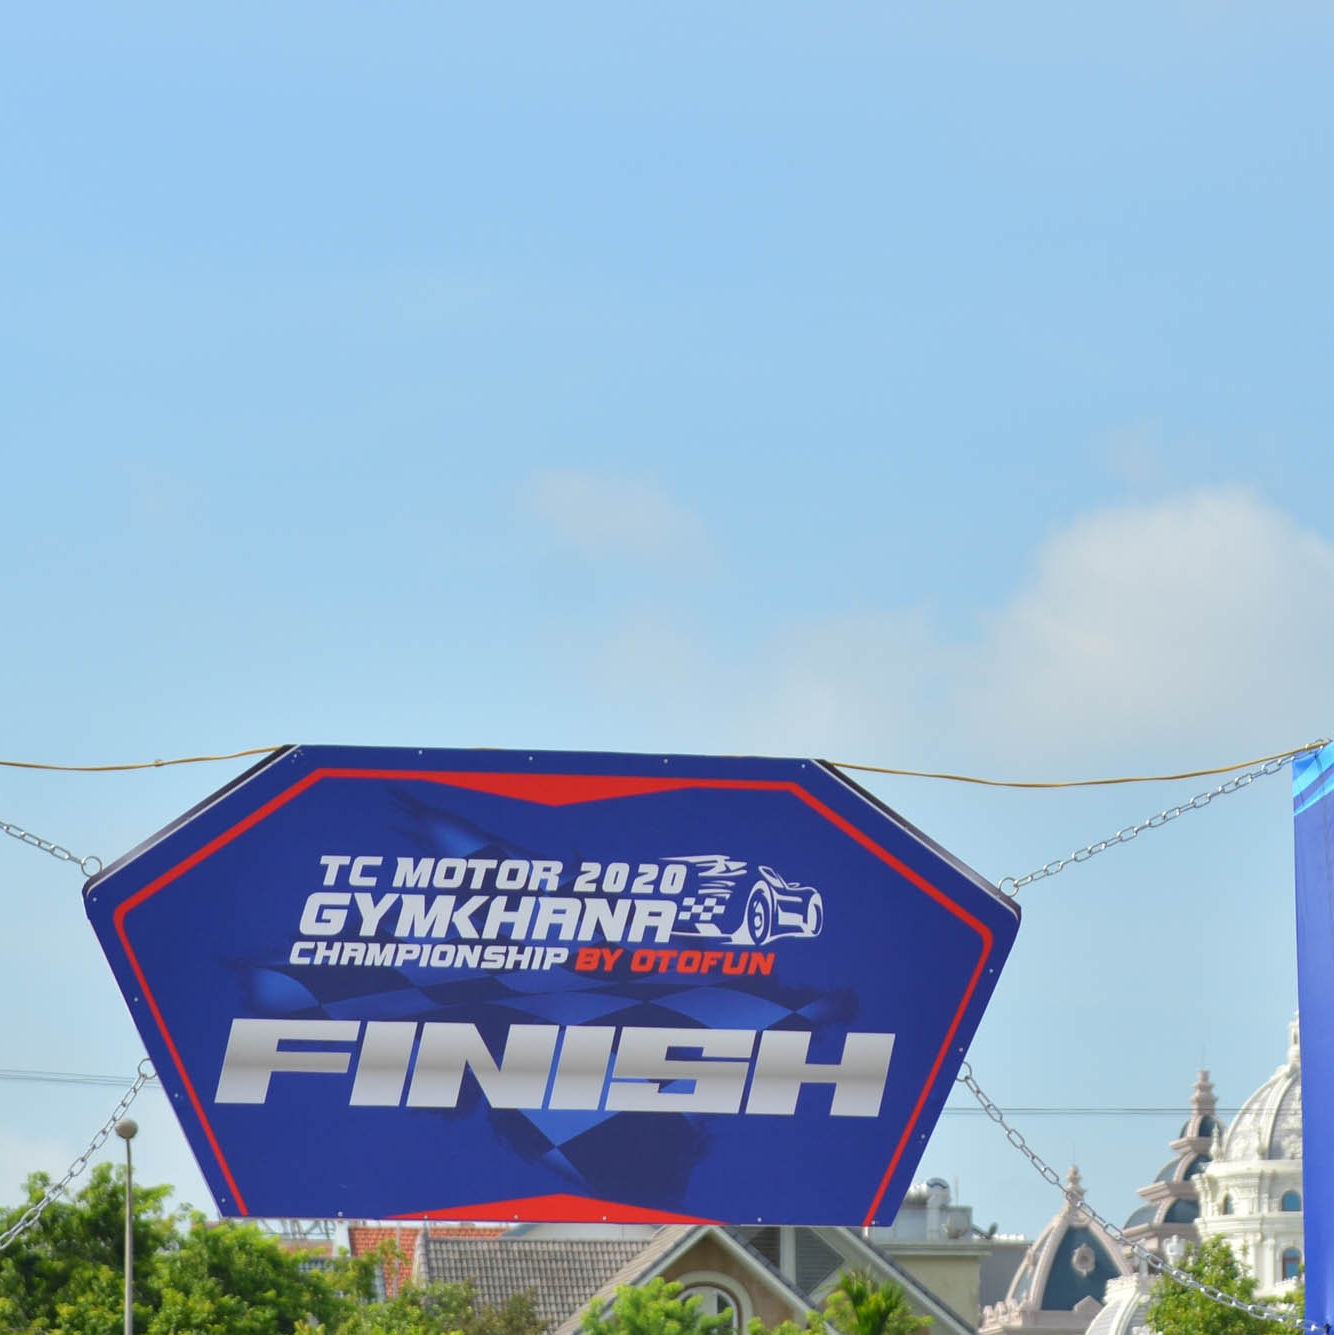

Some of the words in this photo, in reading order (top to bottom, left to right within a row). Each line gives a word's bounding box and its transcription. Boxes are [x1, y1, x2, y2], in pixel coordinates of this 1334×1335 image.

[319, 855, 384, 887] TC
[392, 857, 564, 891] MOTOR
[573, 862, 688, 894] 2020
[299, 892, 680, 943] GYMKHANA
[289, 942, 569, 971] CHAMPIONSHIP
[575, 947, 620, 972] BY
[630, 950, 776, 976] OTOFUN
[214, 1018, 896, 1117] FINISH
